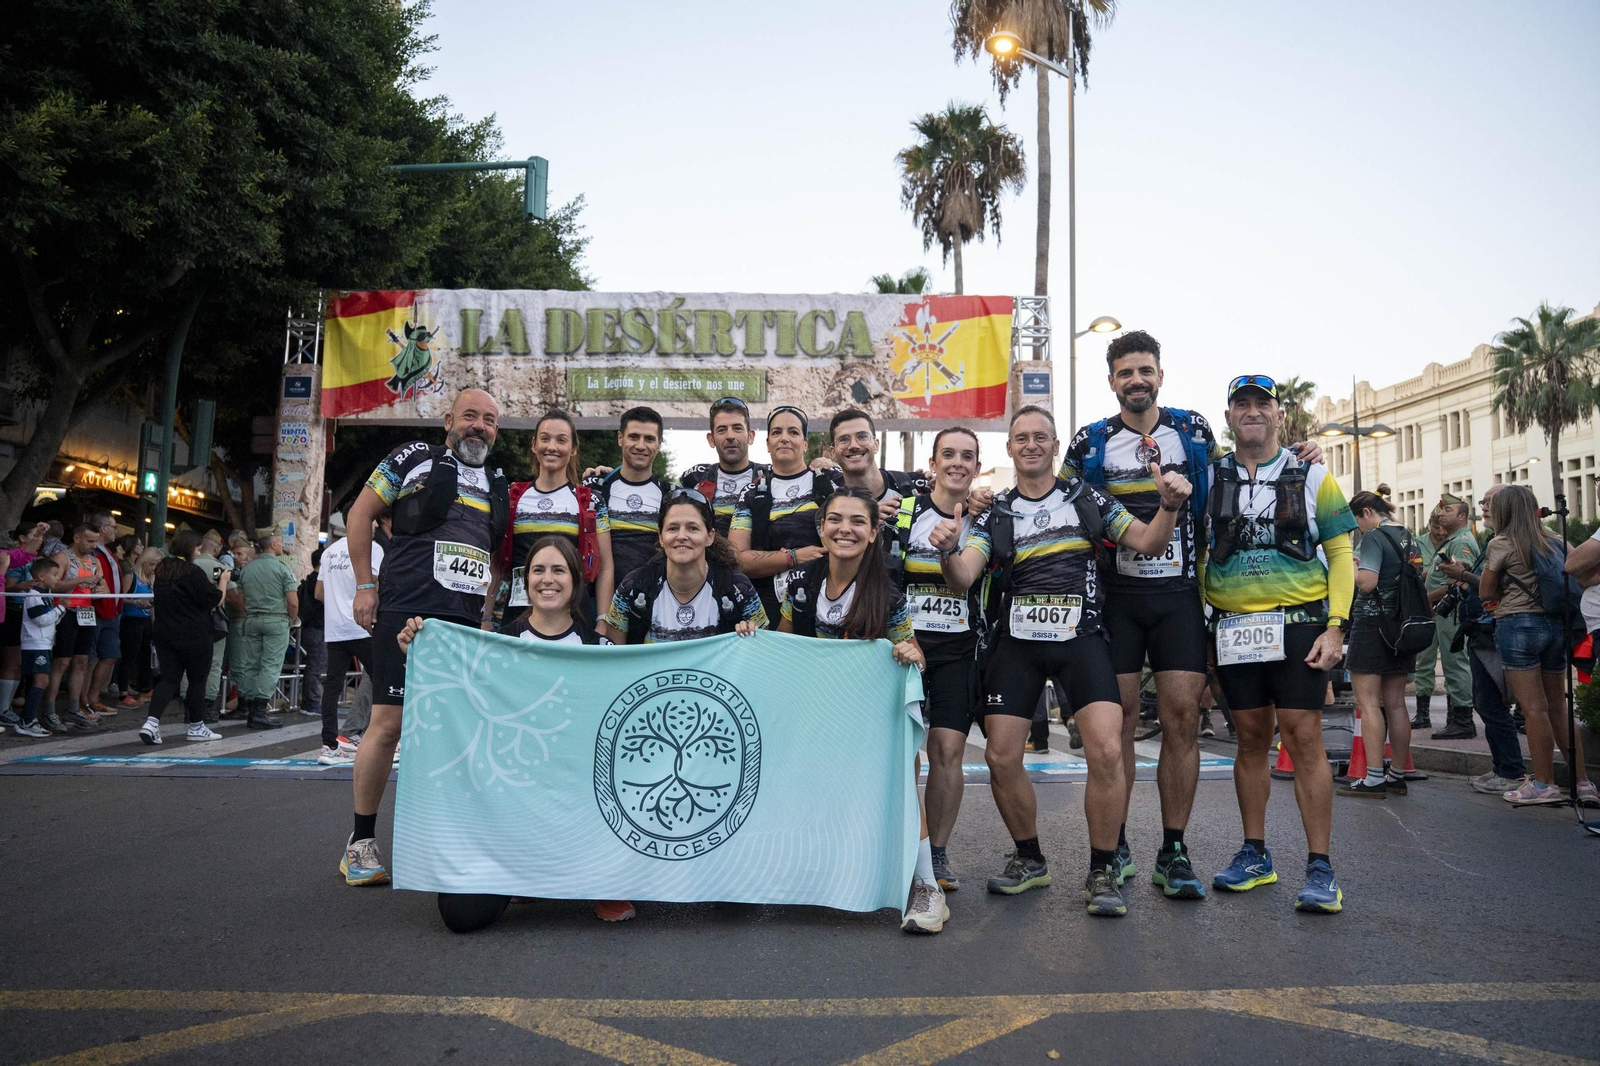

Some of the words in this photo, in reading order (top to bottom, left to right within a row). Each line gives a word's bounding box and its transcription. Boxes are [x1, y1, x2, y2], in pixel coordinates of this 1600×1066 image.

[462, 308, 531, 355] LA
[544, 298, 875, 357] DESÉRTICA
[587, 377, 599, 389] La
[604, 375, 633, 390] Legión
[639, 379, 645, 391] y
[650, 378, 659, 389] el
[663, 378, 701, 390] desierto
[706, 381, 722, 390] nos
[728, 380, 744, 391] une
[81, 473, 136, 495] AUTOMOVI
[449, 557, 484, 579] 4429
[451, 582, 471, 591] asisa
[921, 597, 961, 616] 4425
[1026, 607, 1072, 624] 4067
[1032, 631, 1053, 639] asisa
[1232, 627, 1275, 647] 2906
[1237, 653, 1258, 661] asisa
[605, 684, 649, 730] CLUB
[655, 673, 756, 738] DEPORTIVO
[625, 829, 722, 857] RAICES
